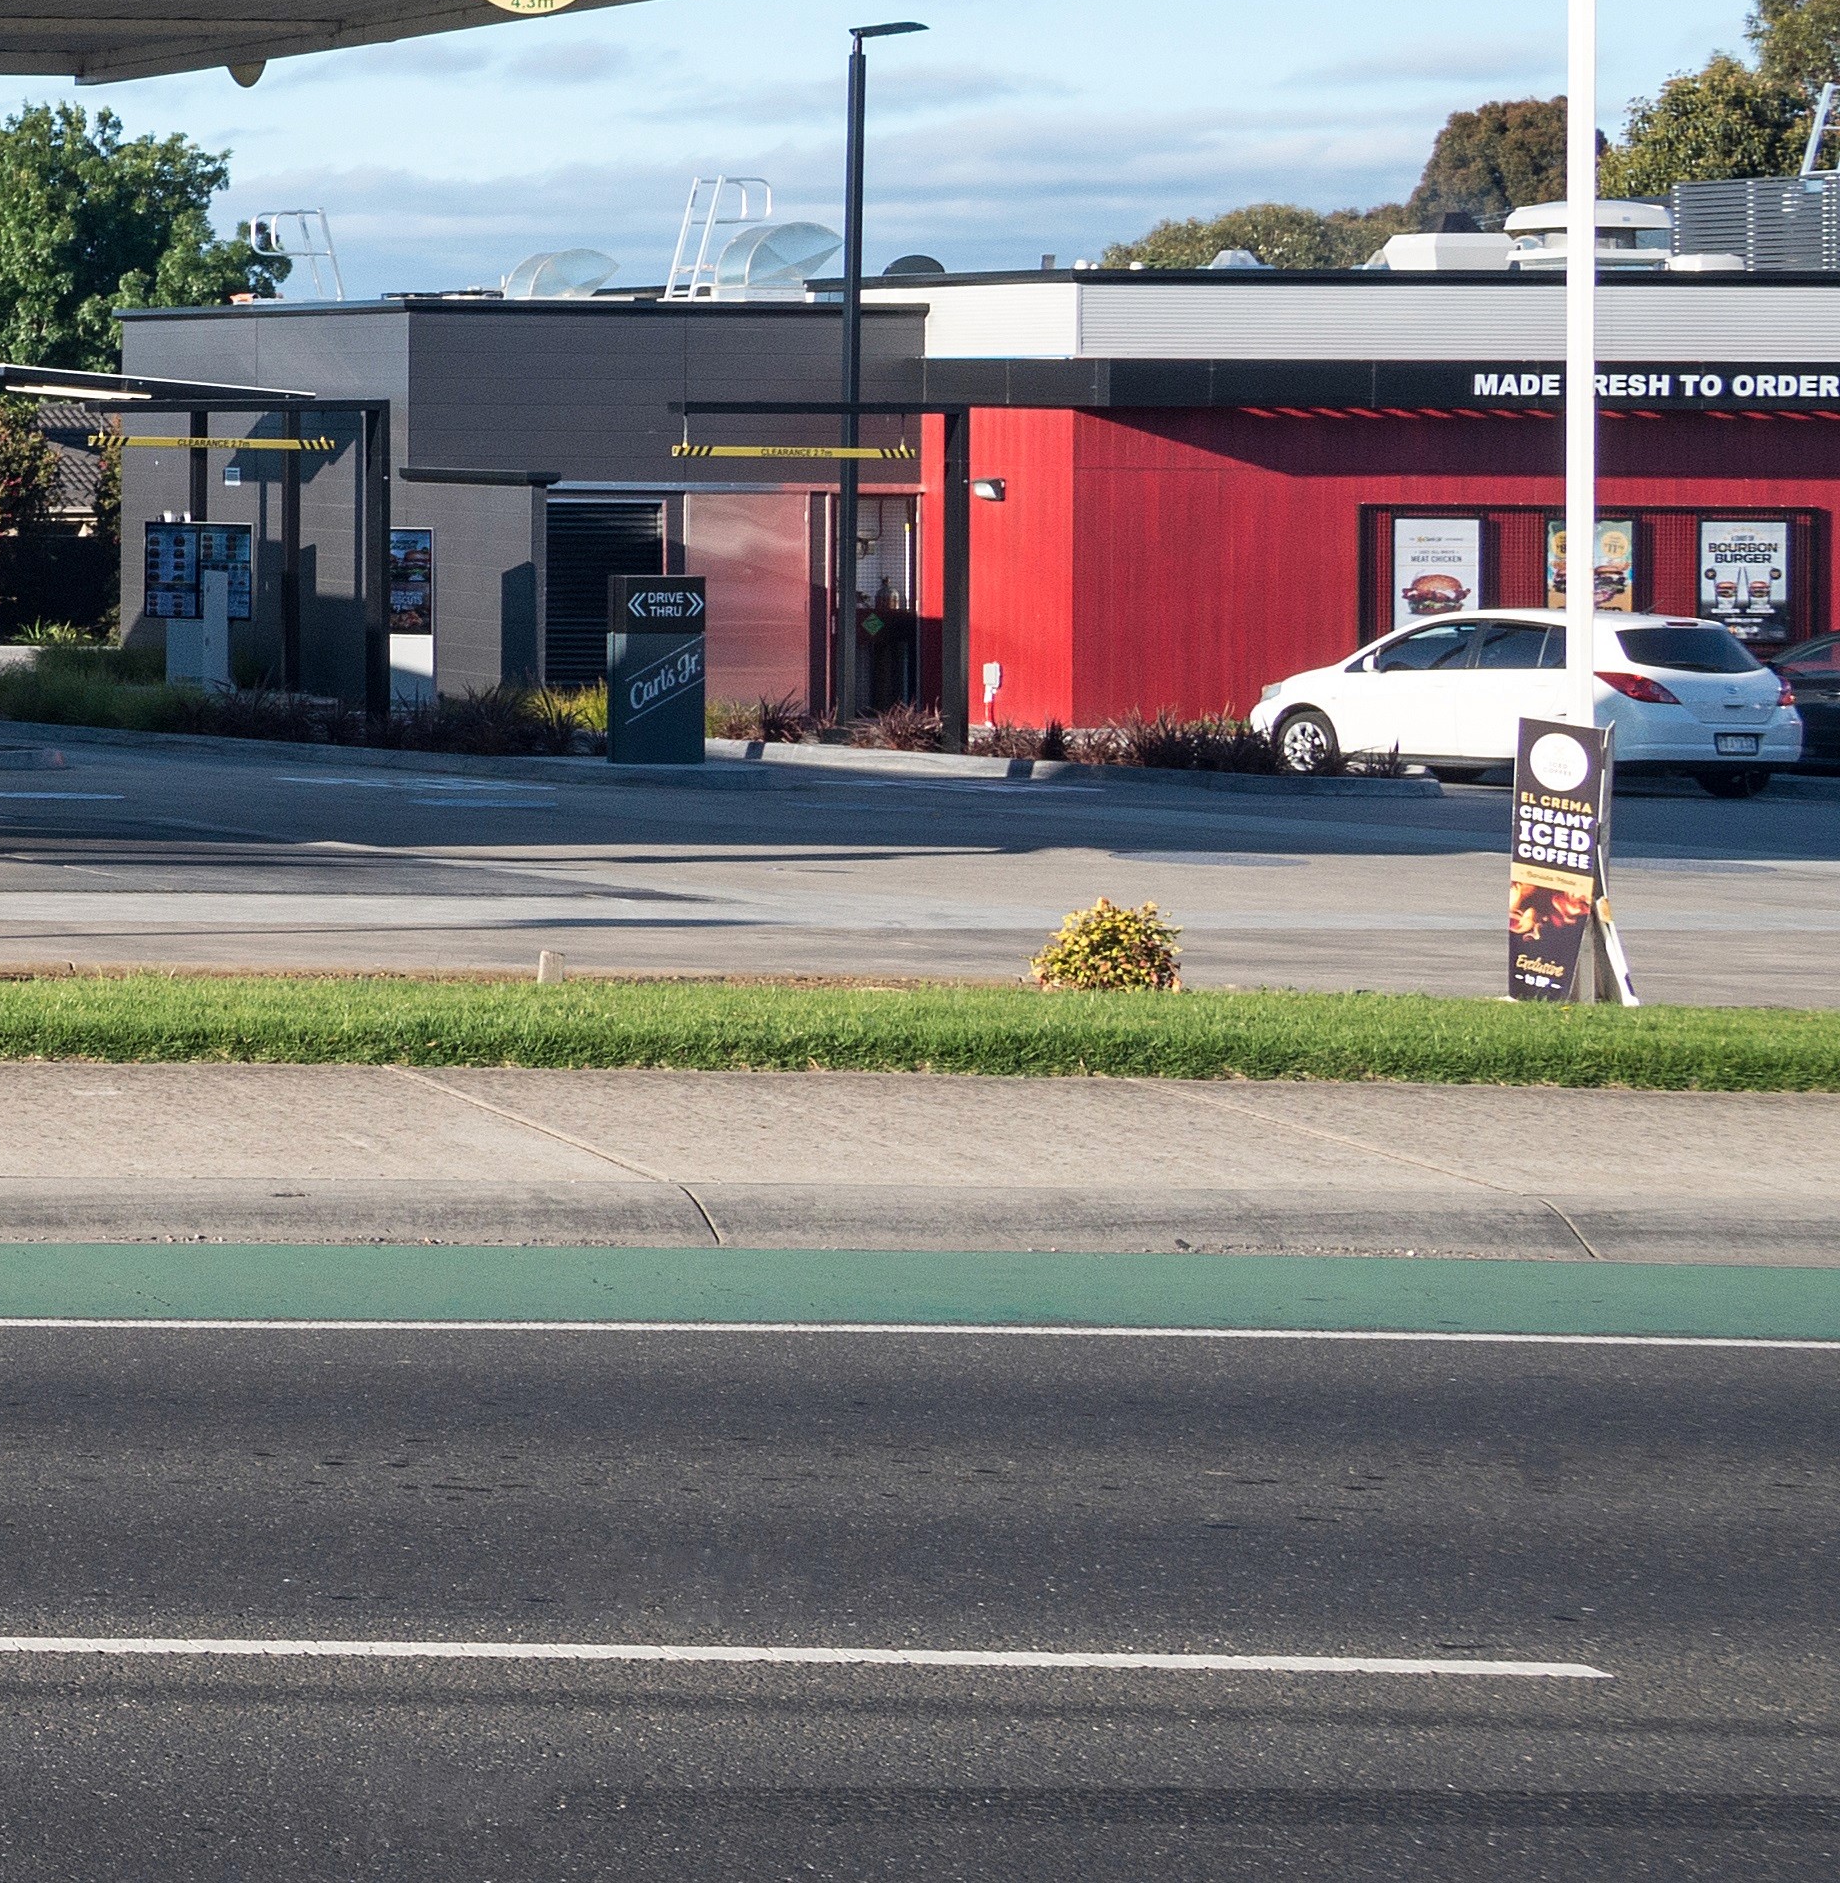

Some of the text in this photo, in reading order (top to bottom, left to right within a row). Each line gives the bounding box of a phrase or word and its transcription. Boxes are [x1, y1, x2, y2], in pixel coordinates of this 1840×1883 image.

[1473, 373, 1840, 397] MADE RESH TO ORDER
[177, 438, 250, 448] CLEARANCE 2.7m
[760, 448, 811, 456] CLEARANCE
[1708, 542, 1779, 553] BOURBON
[1410, 555, 1462, 563] MEAT CHICKEN
[1714, 553, 1772, 564] BURGER
[647, 592, 684, 604] DRIVE
[650, 606, 682, 617] THRU
[630, 664, 675, 709] Carl's
[1520, 791, 1593, 815] EL CREMA
[1518, 804, 1595, 830] CREAMY
[1518, 820, 1591, 853] ICED
[1517, 842, 1591, 870] COFFEE
[1515, 954, 1565, 978] Exclusive
